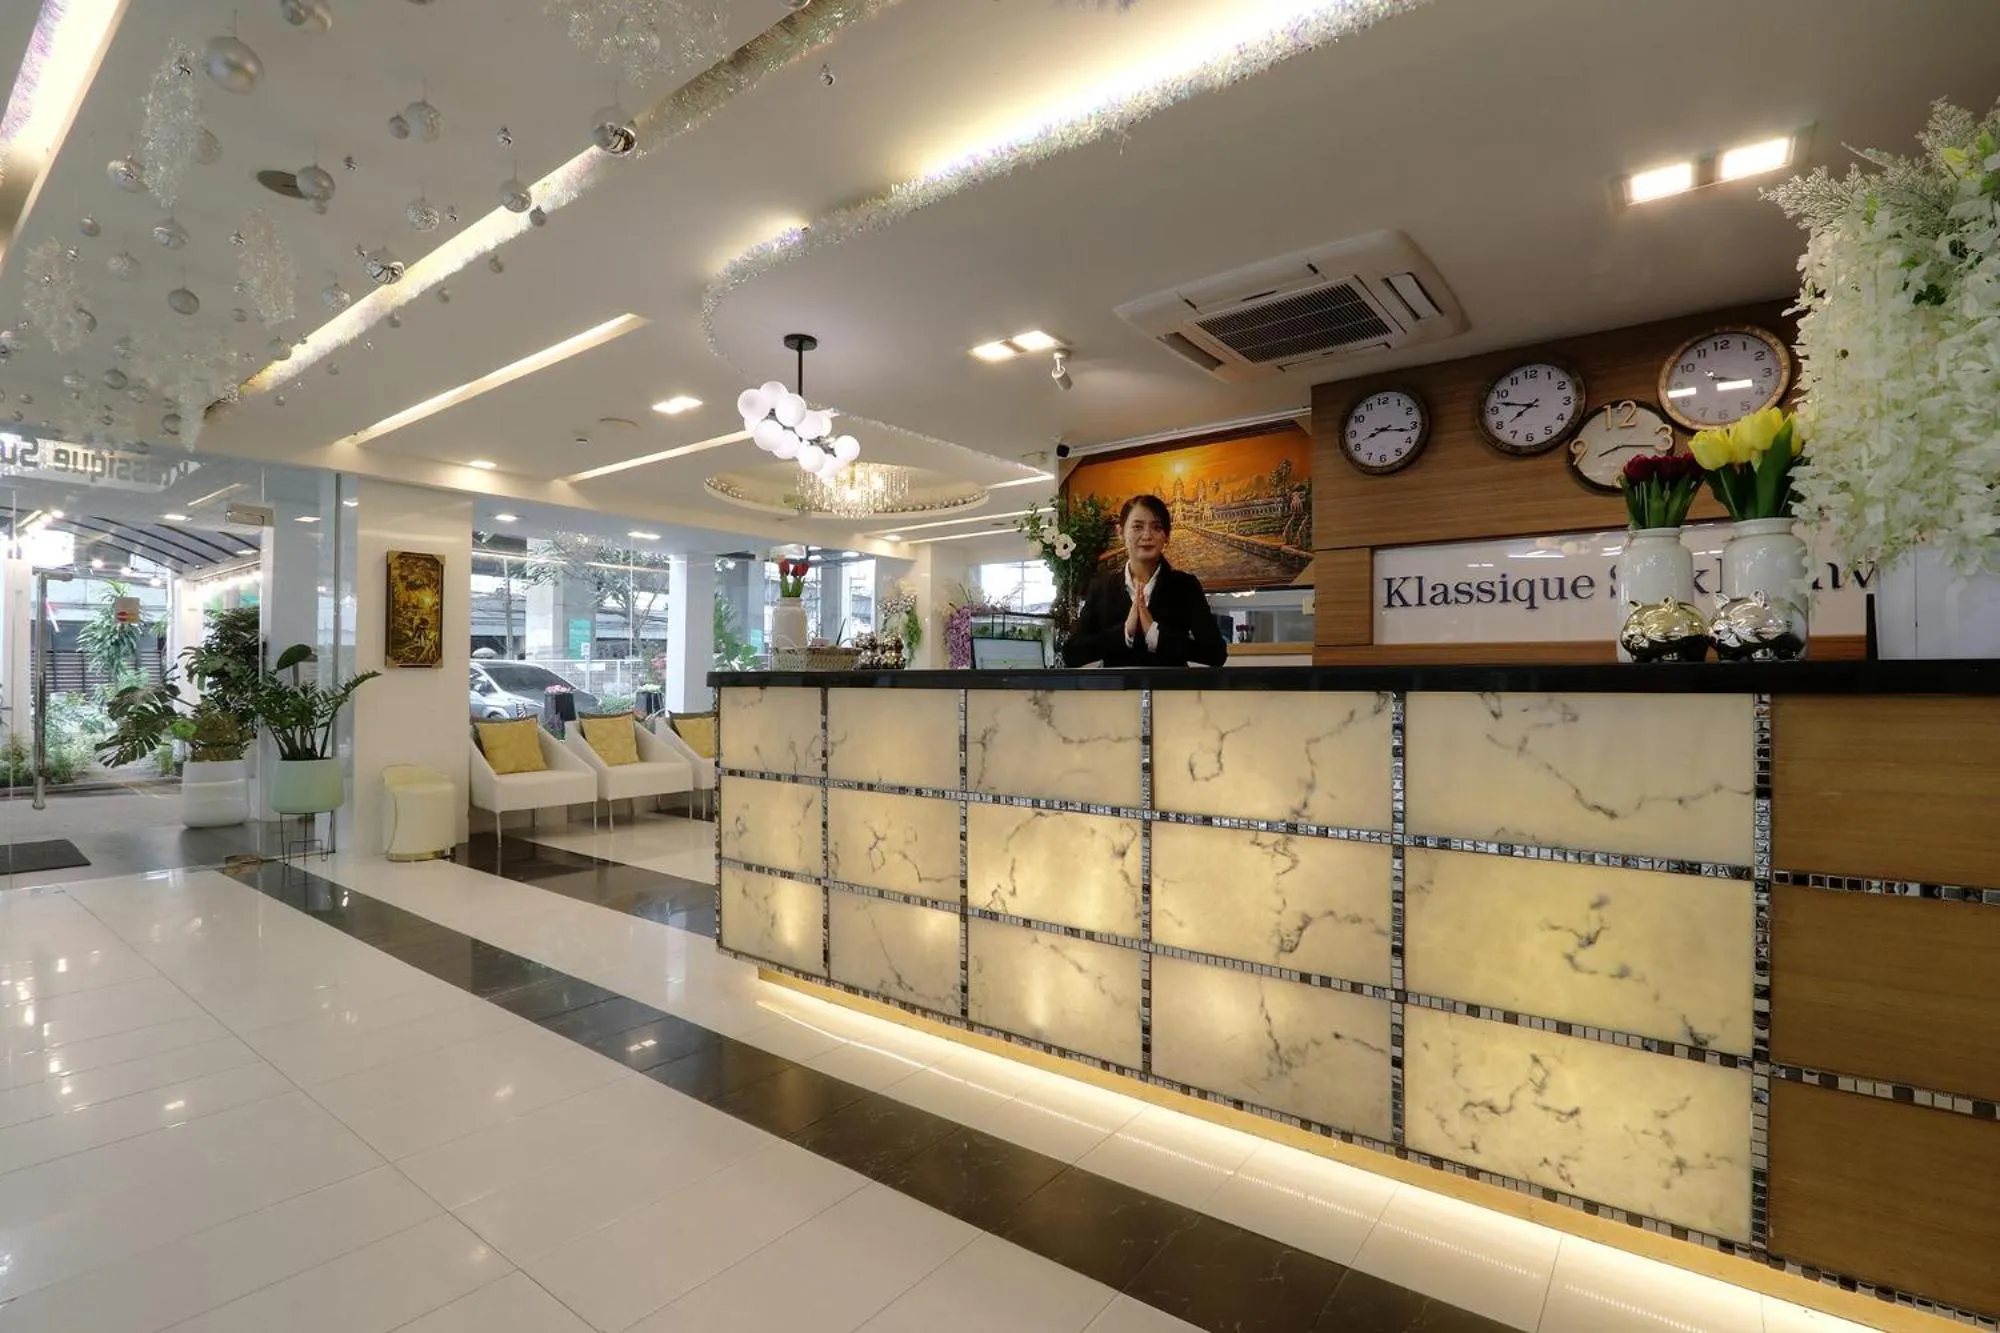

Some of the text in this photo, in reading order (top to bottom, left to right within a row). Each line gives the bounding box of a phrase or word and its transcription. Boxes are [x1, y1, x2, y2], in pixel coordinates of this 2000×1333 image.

[1713, 340, 1730, 351] 12
[1697, 349, 1706, 358] 11
[1754, 351, 1765, 361] 2
[1681, 363, 1695, 374] 10
[1762, 367, 1772, 377] 3
[1524, 369, 1537, 379] 12
[1511, 377, 1518, 385] 11
[1557, 381, 1566, 390] 2
[1497, 389, 1508, 399] 10
[1377, 397, 1389, 405] 12
[1563, 396, 1571, 405] 3
[1366, 403, 1372, 411] 11
[1741, 401, 1750, 411] 5
[1406, 407, 1413, 415] 2
[1491, 407, 1499, 415] 9
[1603, 400, 1637, 430] 12
[1699, 408, 1708, 417] 7
[1354, 415, 1364, 423] 10
[1557, 413, 1564, 421] 4
[1410, 421, 1417, 429] 3
[1496, 421, 1503, 429] 8
[1350, 430, 1356, 438] 9
[1510, 430, 1517, 439] 7
[1544, 426, 1552, 435] 5
[1405, 436, 1412, 444] 4
[1526, 433, 1534, 441] 6
[1655, 424, 1673, 450] 3
[1395, 448, 1401, 456] 5
[1570, 439, 1588, 465] 9
[1380, 455, 1386, 463] 6
[1383, 573, 1595, 610] Klassique
